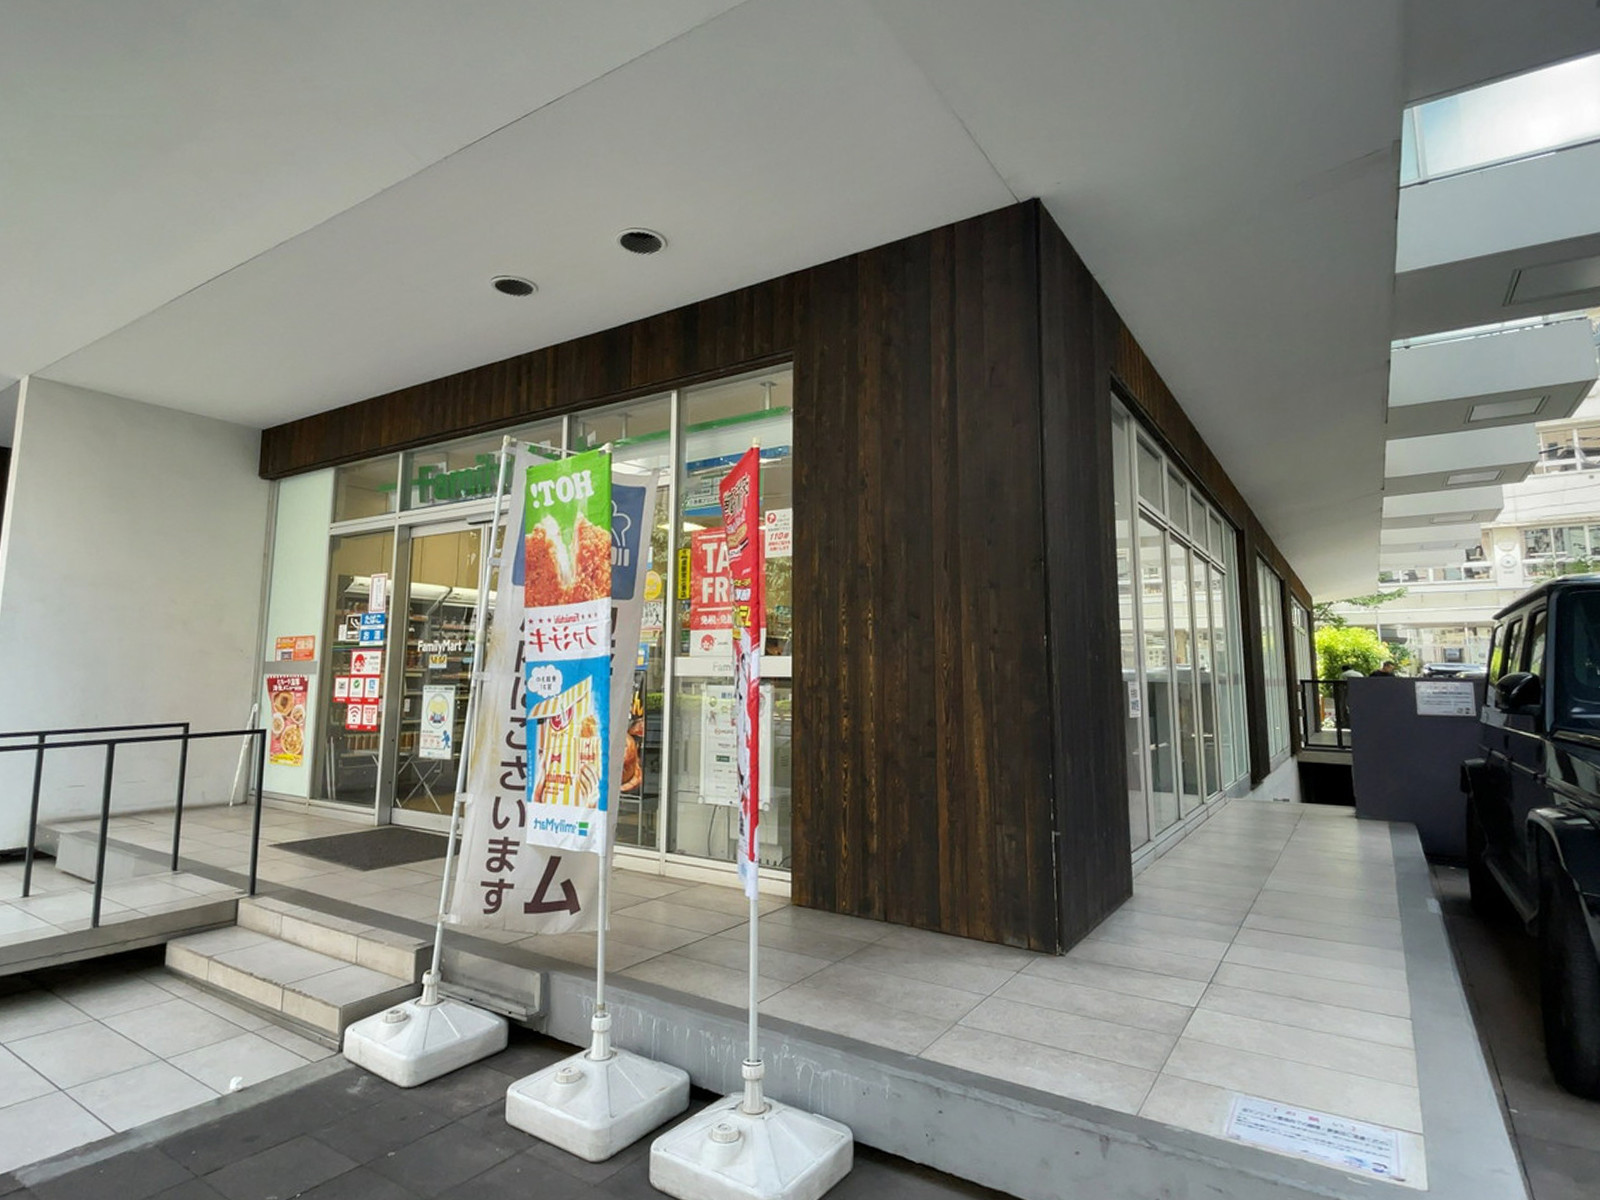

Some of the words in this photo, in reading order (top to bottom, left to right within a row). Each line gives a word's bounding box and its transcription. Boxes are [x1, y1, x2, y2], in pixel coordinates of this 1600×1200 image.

[702, 540, 731, 574] TA
[702, 576, 731, 604] FR
[417, 639, 463, 655] FamilyMart
